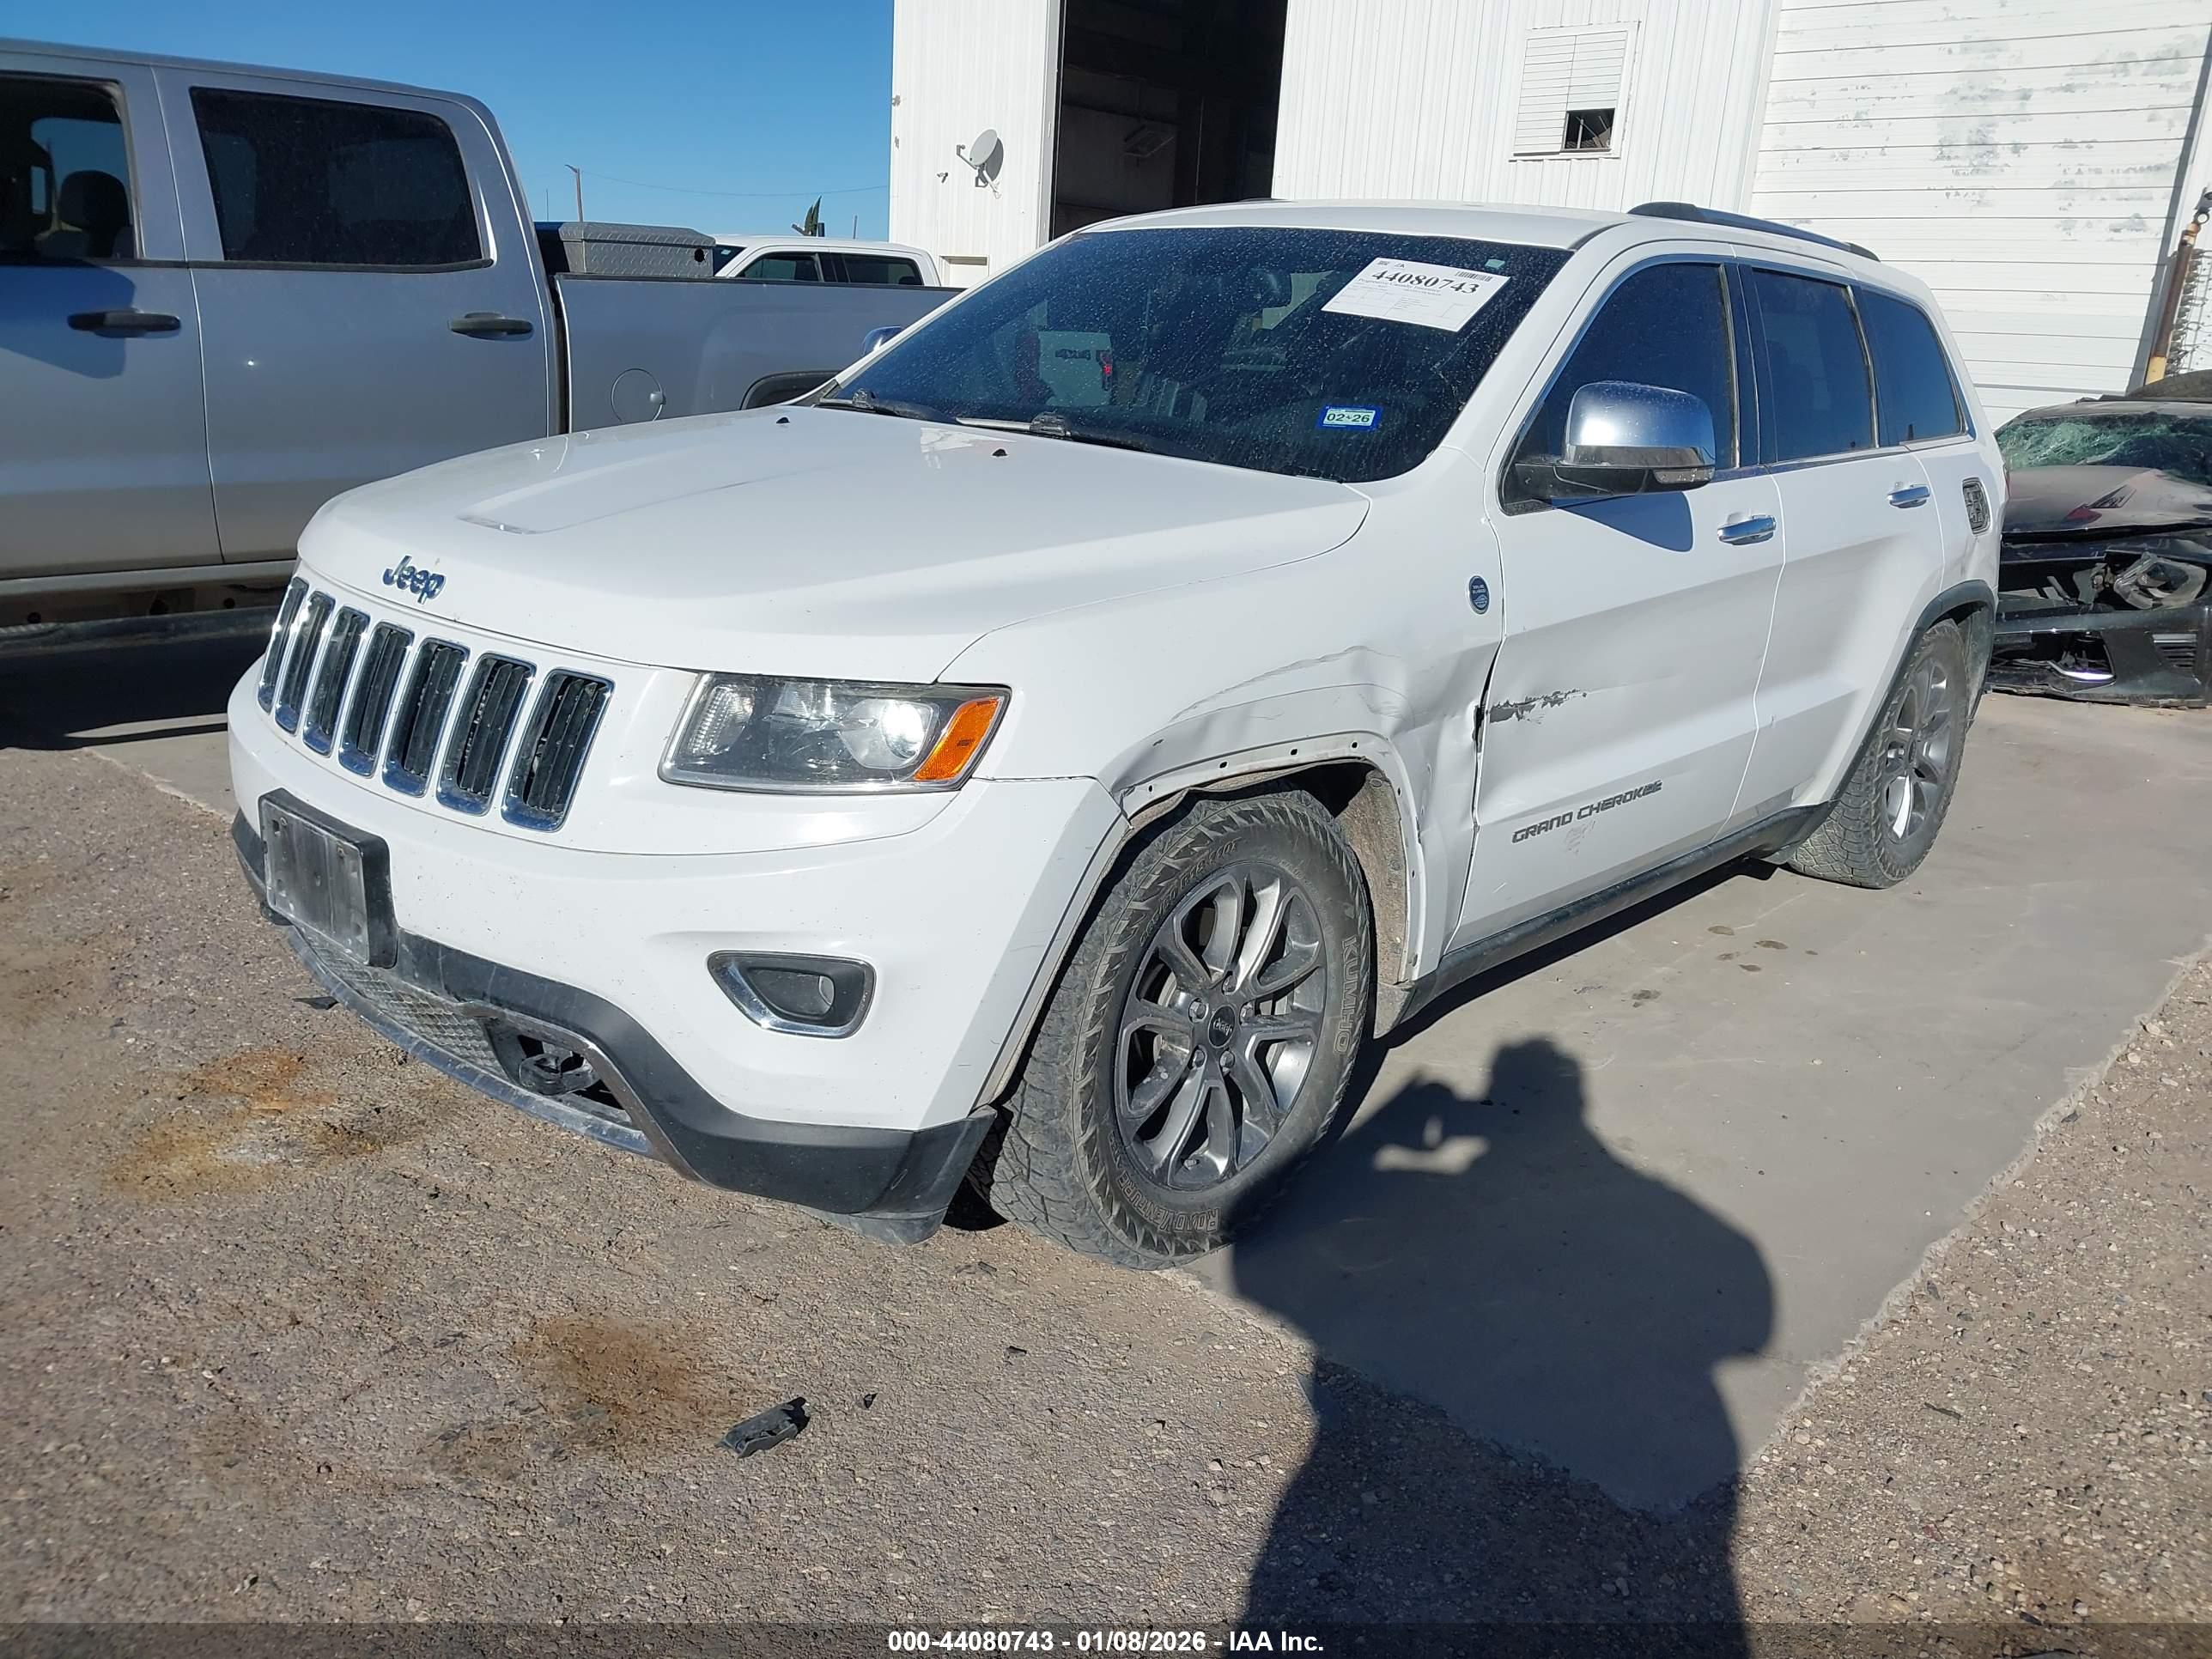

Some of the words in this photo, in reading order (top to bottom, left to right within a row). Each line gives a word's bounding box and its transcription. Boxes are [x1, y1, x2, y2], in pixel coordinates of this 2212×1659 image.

[1371, 270, 1480, 294] 44080743
[382, 555, 446, 605] Jeep
[1511, 811, 1574, 843] GRAND
[1577, 779, 1663, 820] CHEROKEE
[1334, 934, 1358, 1054] KUMHO
